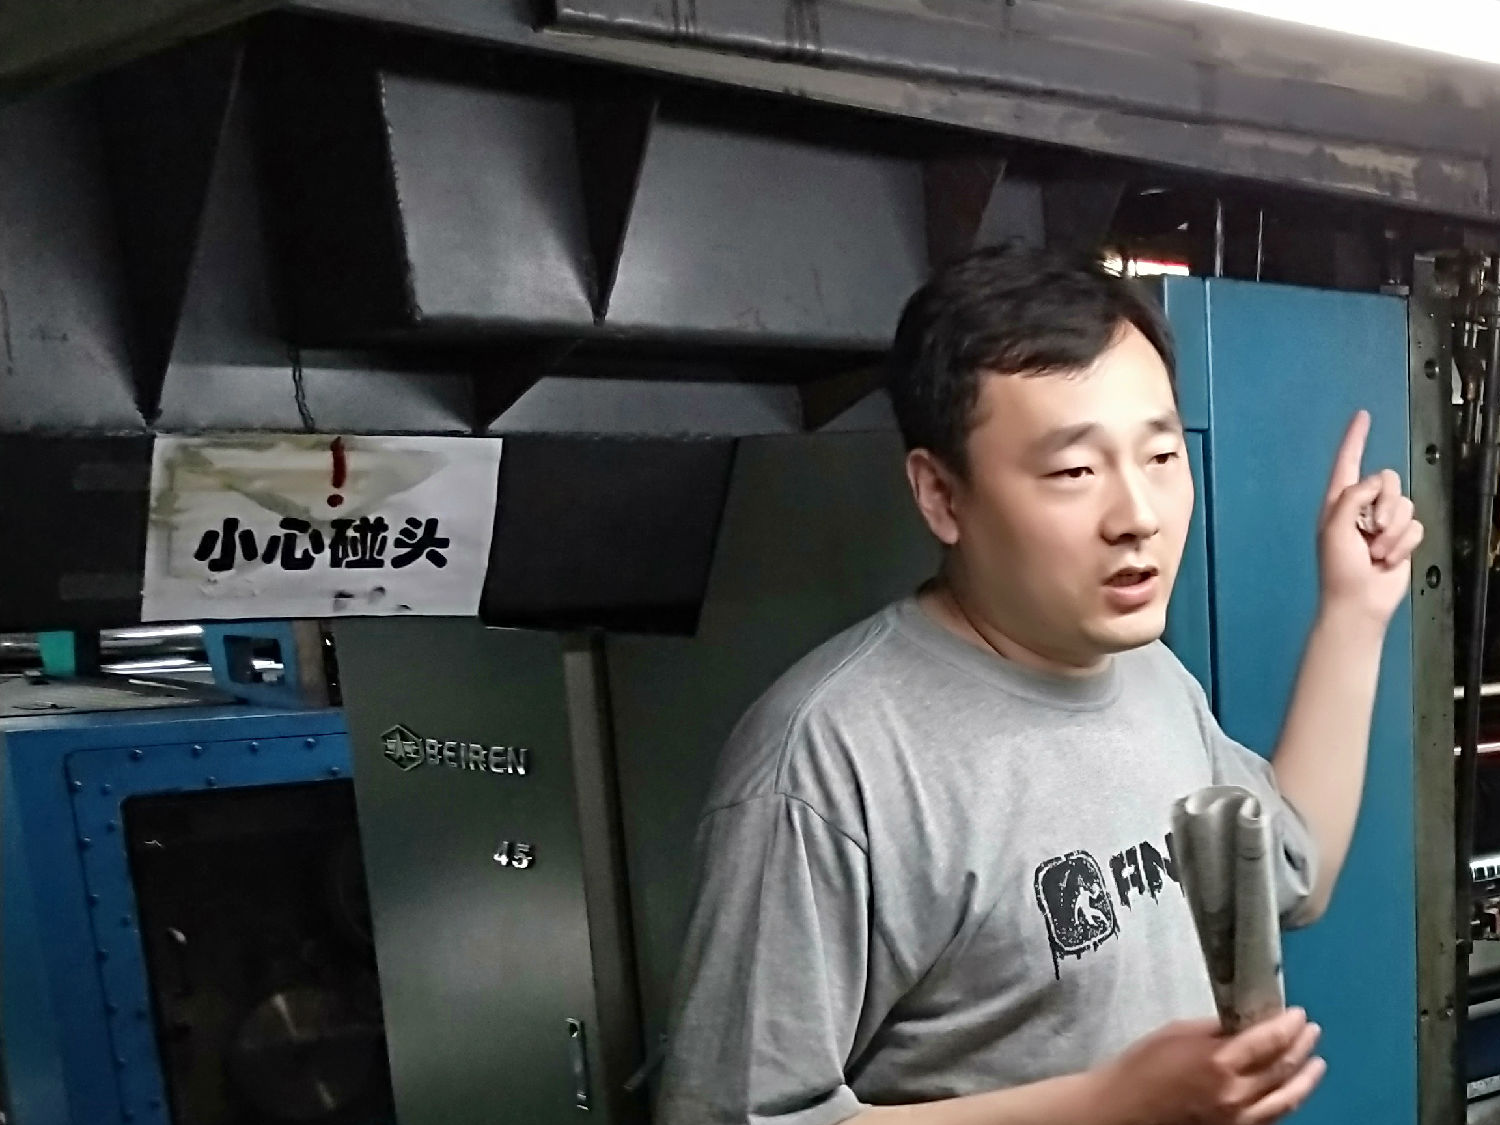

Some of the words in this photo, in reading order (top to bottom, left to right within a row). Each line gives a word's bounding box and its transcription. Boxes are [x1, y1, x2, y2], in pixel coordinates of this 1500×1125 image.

[194, 516, 450, 572] 小心碰头
[425, 738, 529, 775] BEIREN
[493, 841, 533, 869] 45
